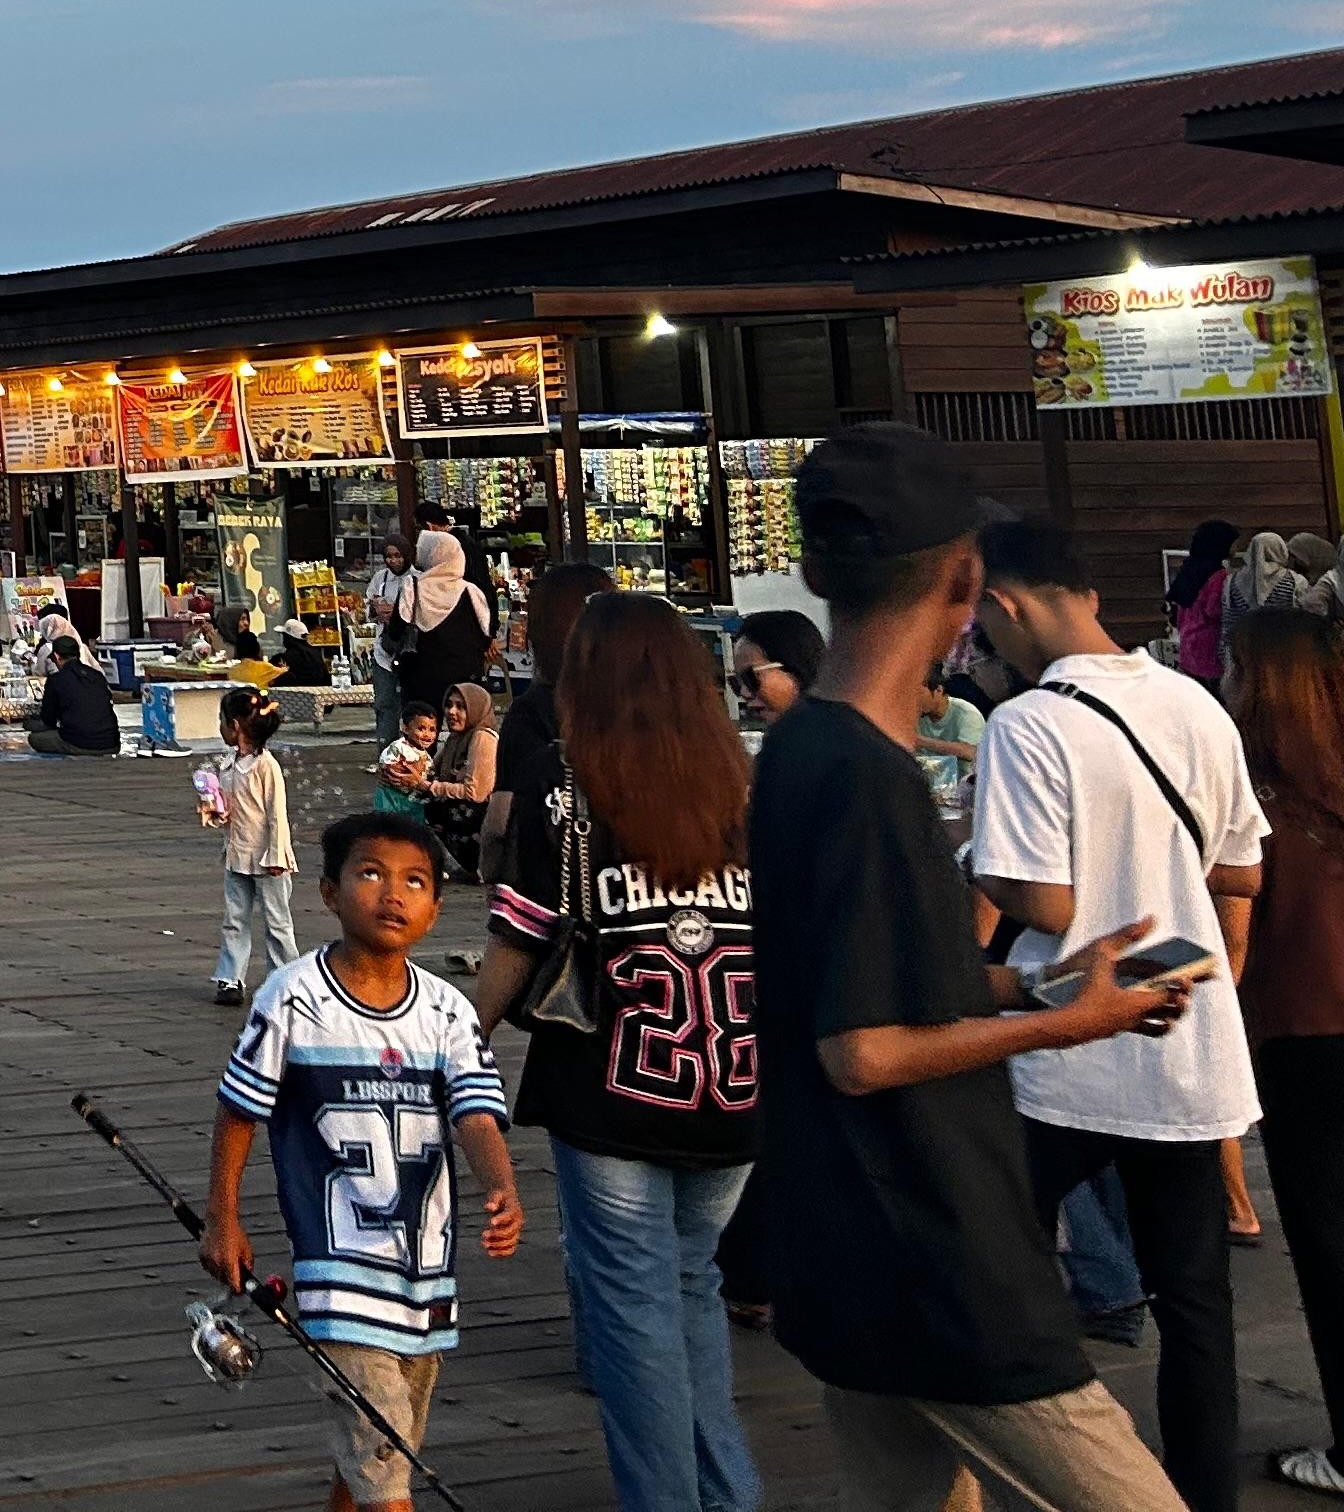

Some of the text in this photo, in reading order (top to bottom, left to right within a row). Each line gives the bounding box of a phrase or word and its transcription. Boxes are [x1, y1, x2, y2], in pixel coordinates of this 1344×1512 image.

[1063, 287, 1120, 316] Kios
[1190, 271, 1274, 308] Wulan
[258, 370, 297, 395] Kedai
[252, 516, 283, 528] RAYA
[314, 1102, 454, 1277] 27
